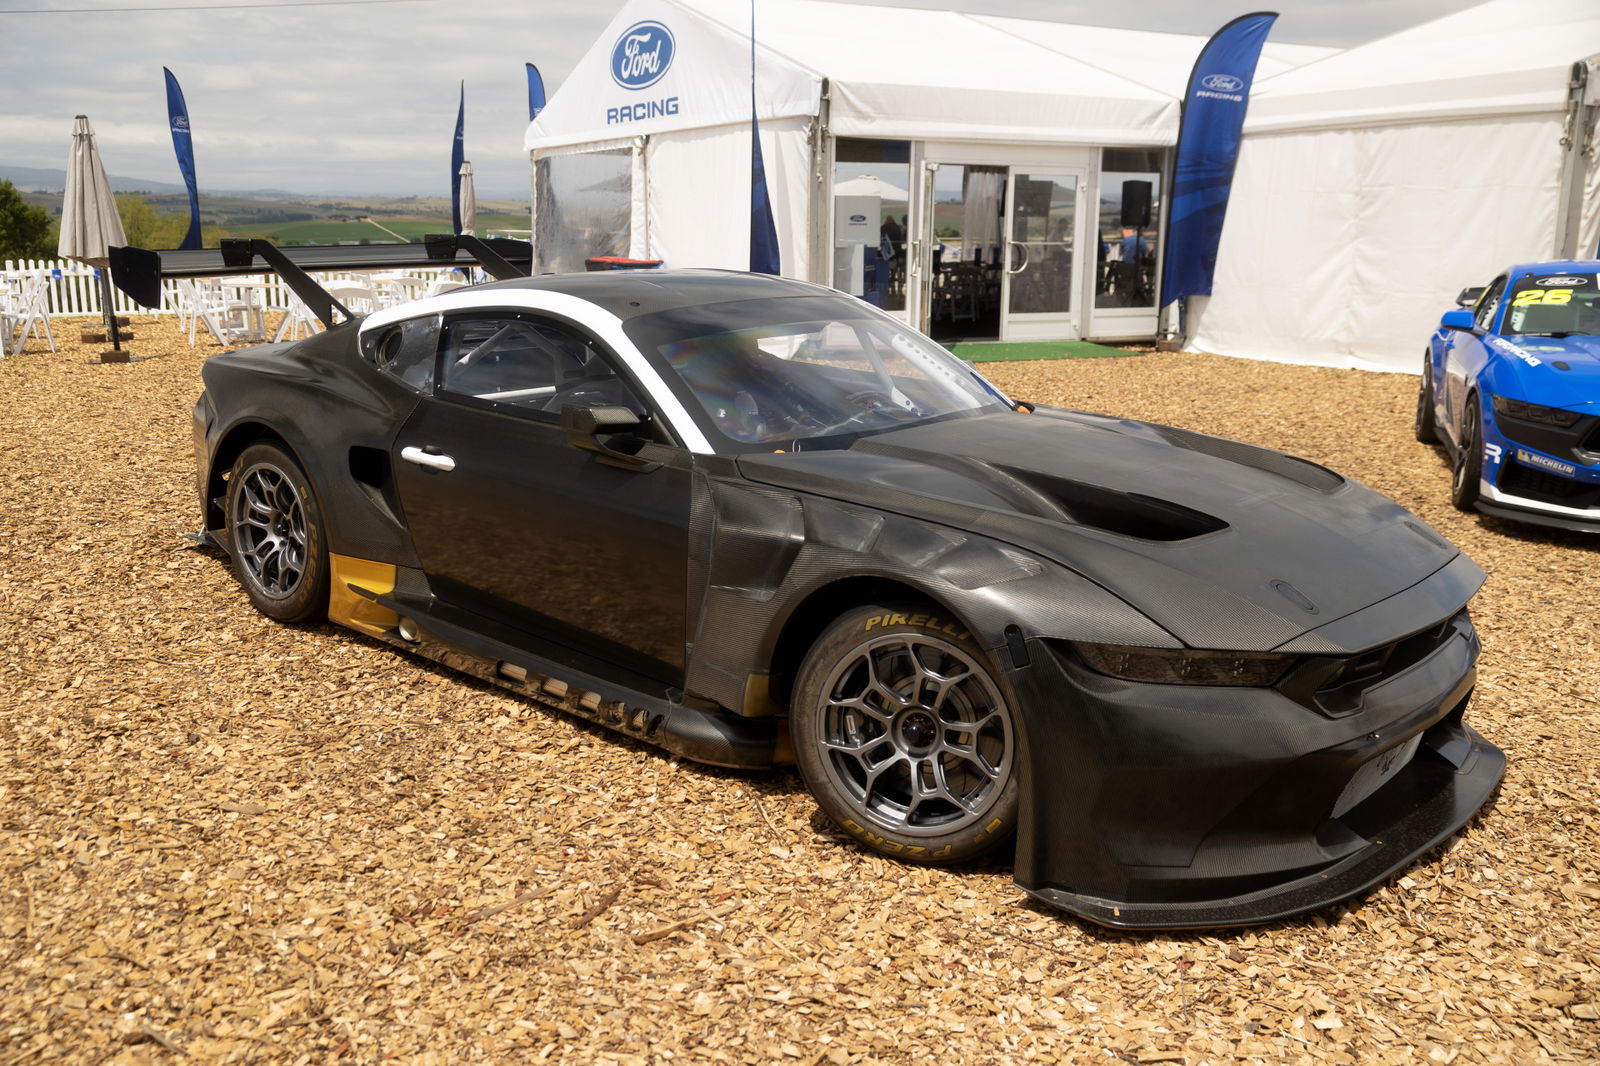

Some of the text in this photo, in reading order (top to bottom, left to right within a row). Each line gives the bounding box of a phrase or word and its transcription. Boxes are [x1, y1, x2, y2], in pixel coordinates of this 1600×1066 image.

[621, 32, 661, 79] Ford
[607, 97, 679, 125] RACING
[1512, 289, 1574, 307] 26
[1530, 455, 1574, 473] MICHELIN
[865, 613, 972, 640] PIRELLI
